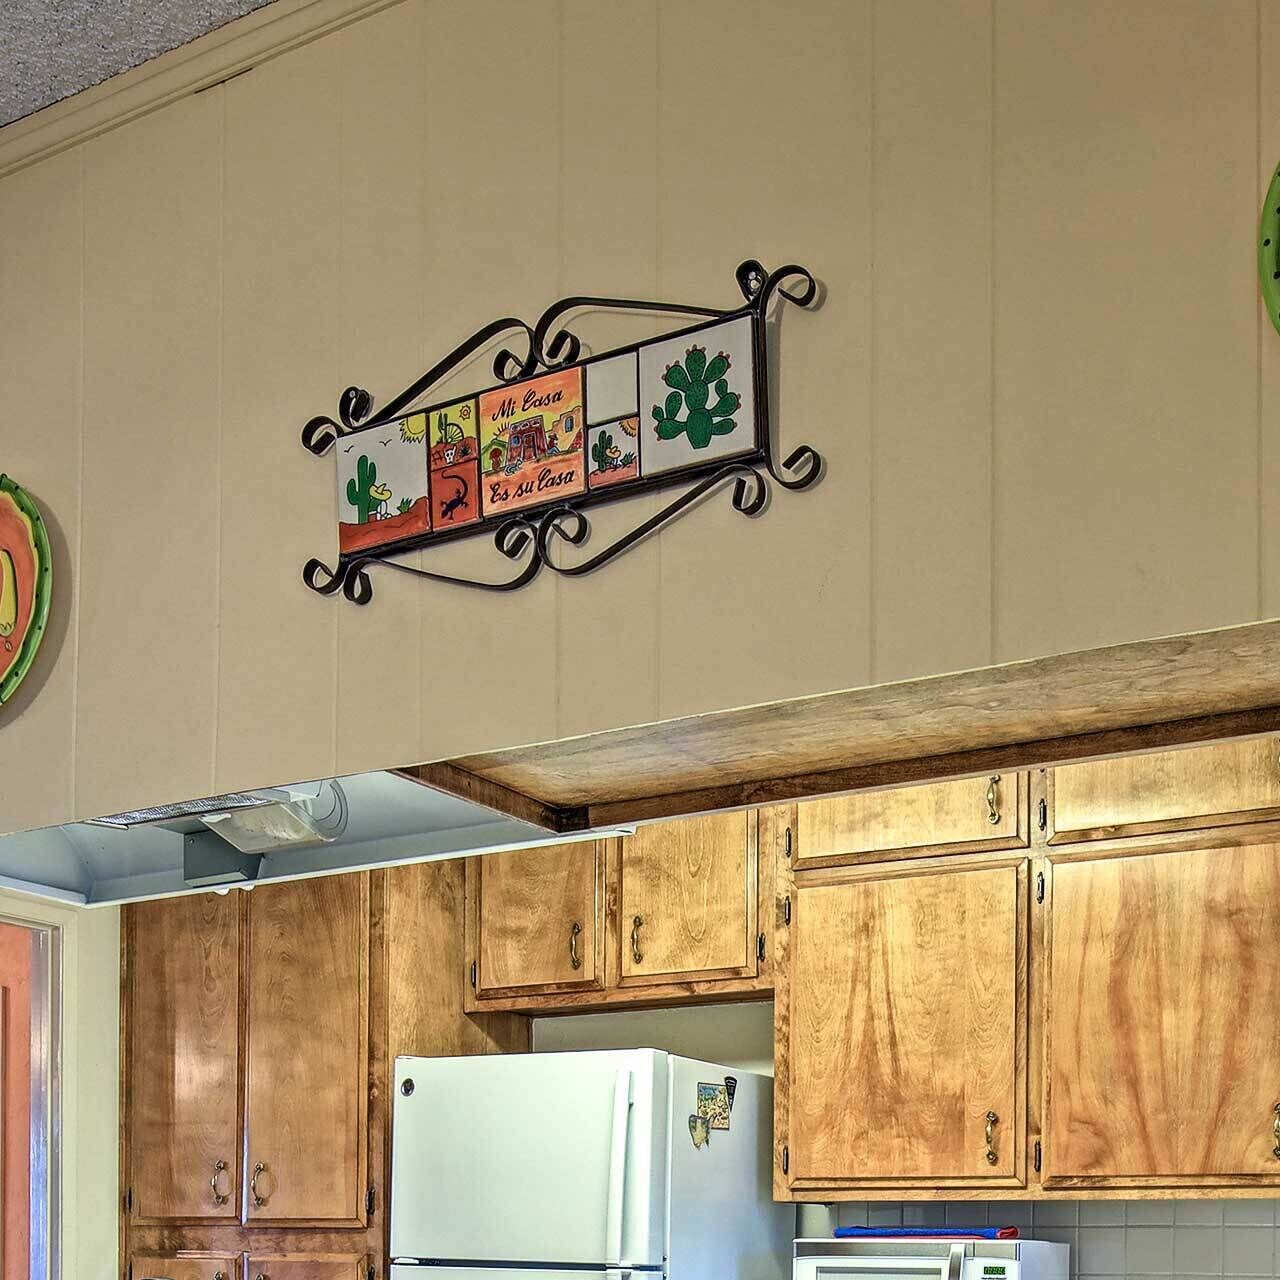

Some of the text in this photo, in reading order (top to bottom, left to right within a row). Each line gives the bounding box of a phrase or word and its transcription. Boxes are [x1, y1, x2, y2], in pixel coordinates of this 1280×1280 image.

[492, 388, 564, 421] Mi Casa
[490, 467, 575, 504] Es su Casa
